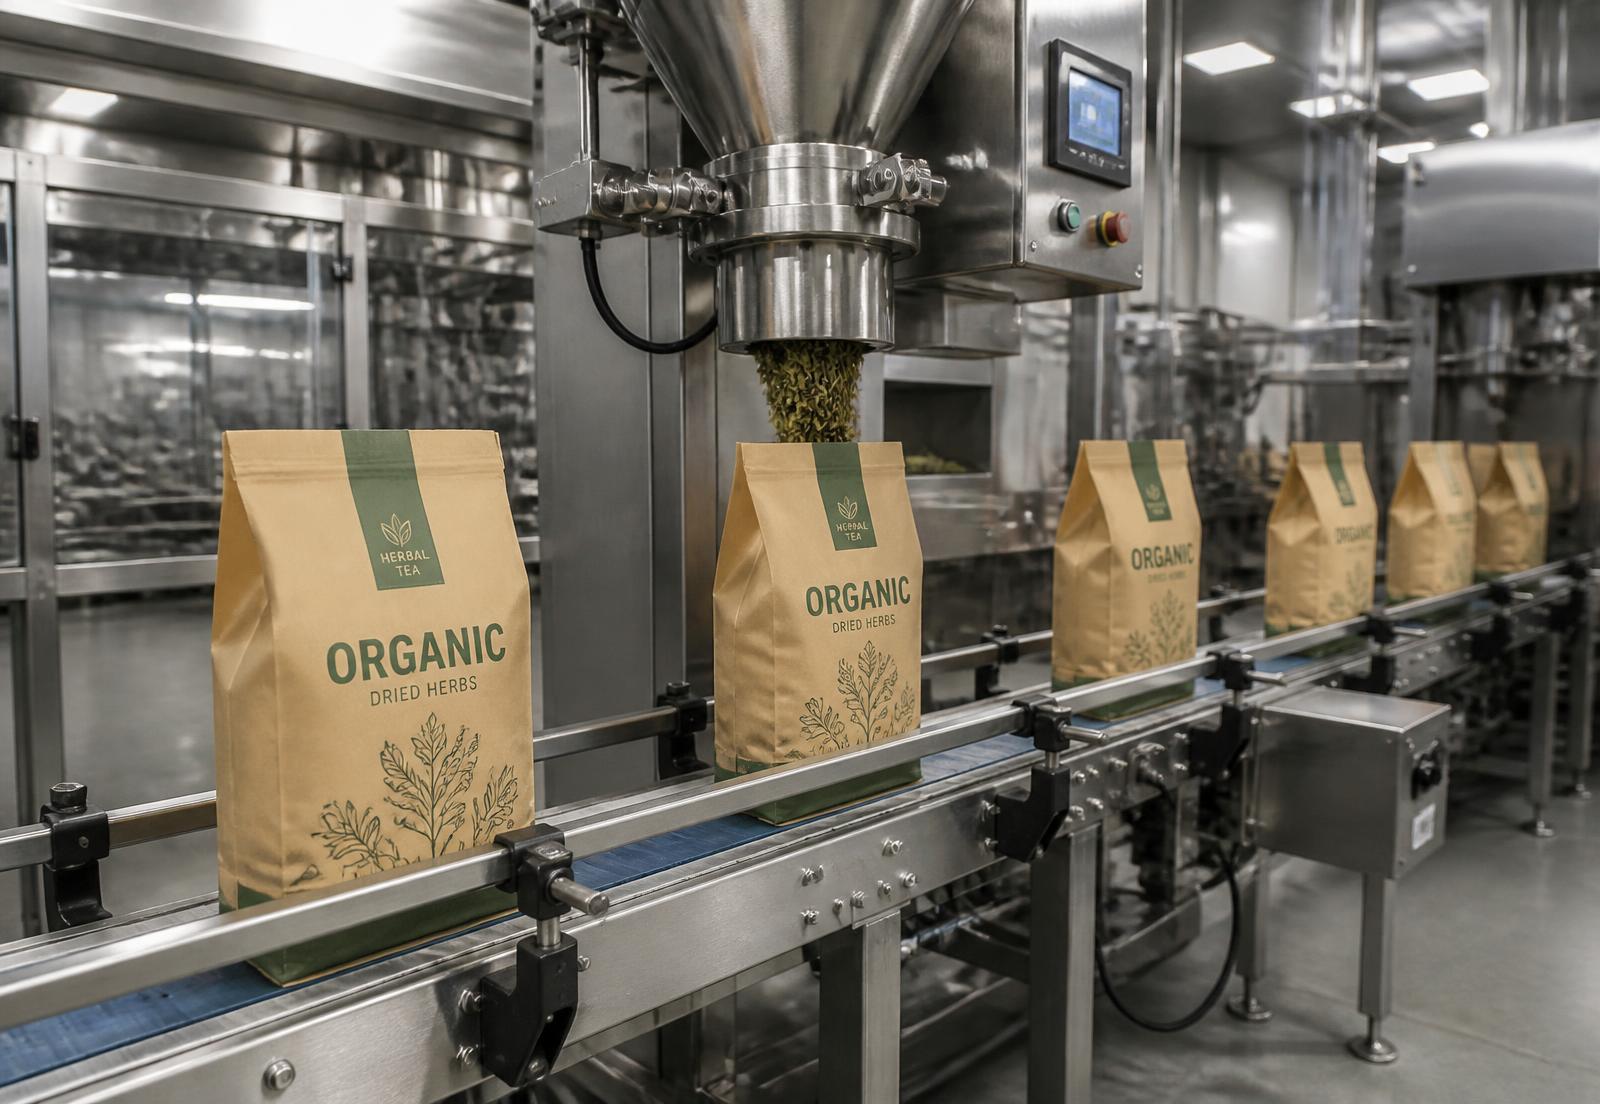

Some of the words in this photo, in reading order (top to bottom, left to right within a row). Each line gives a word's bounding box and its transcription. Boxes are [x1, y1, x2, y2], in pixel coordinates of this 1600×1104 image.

[845, 532, 862, 541] TEA
[380, 549, 431, 564] HERBAL
[1131, 541, 1194, 571] ORGANIC
[395, 564, 421, 577] TEA
[806, 575, 911, 617] ORGANIC
[832, 618, 863, 633] DRIED
[866, 613, 896, 629] HERBS
[326, 622, 506, 685] ORGANIC
[370, 684, 420, 706] DRIED
[427, 675, 478, 698] HERBS
